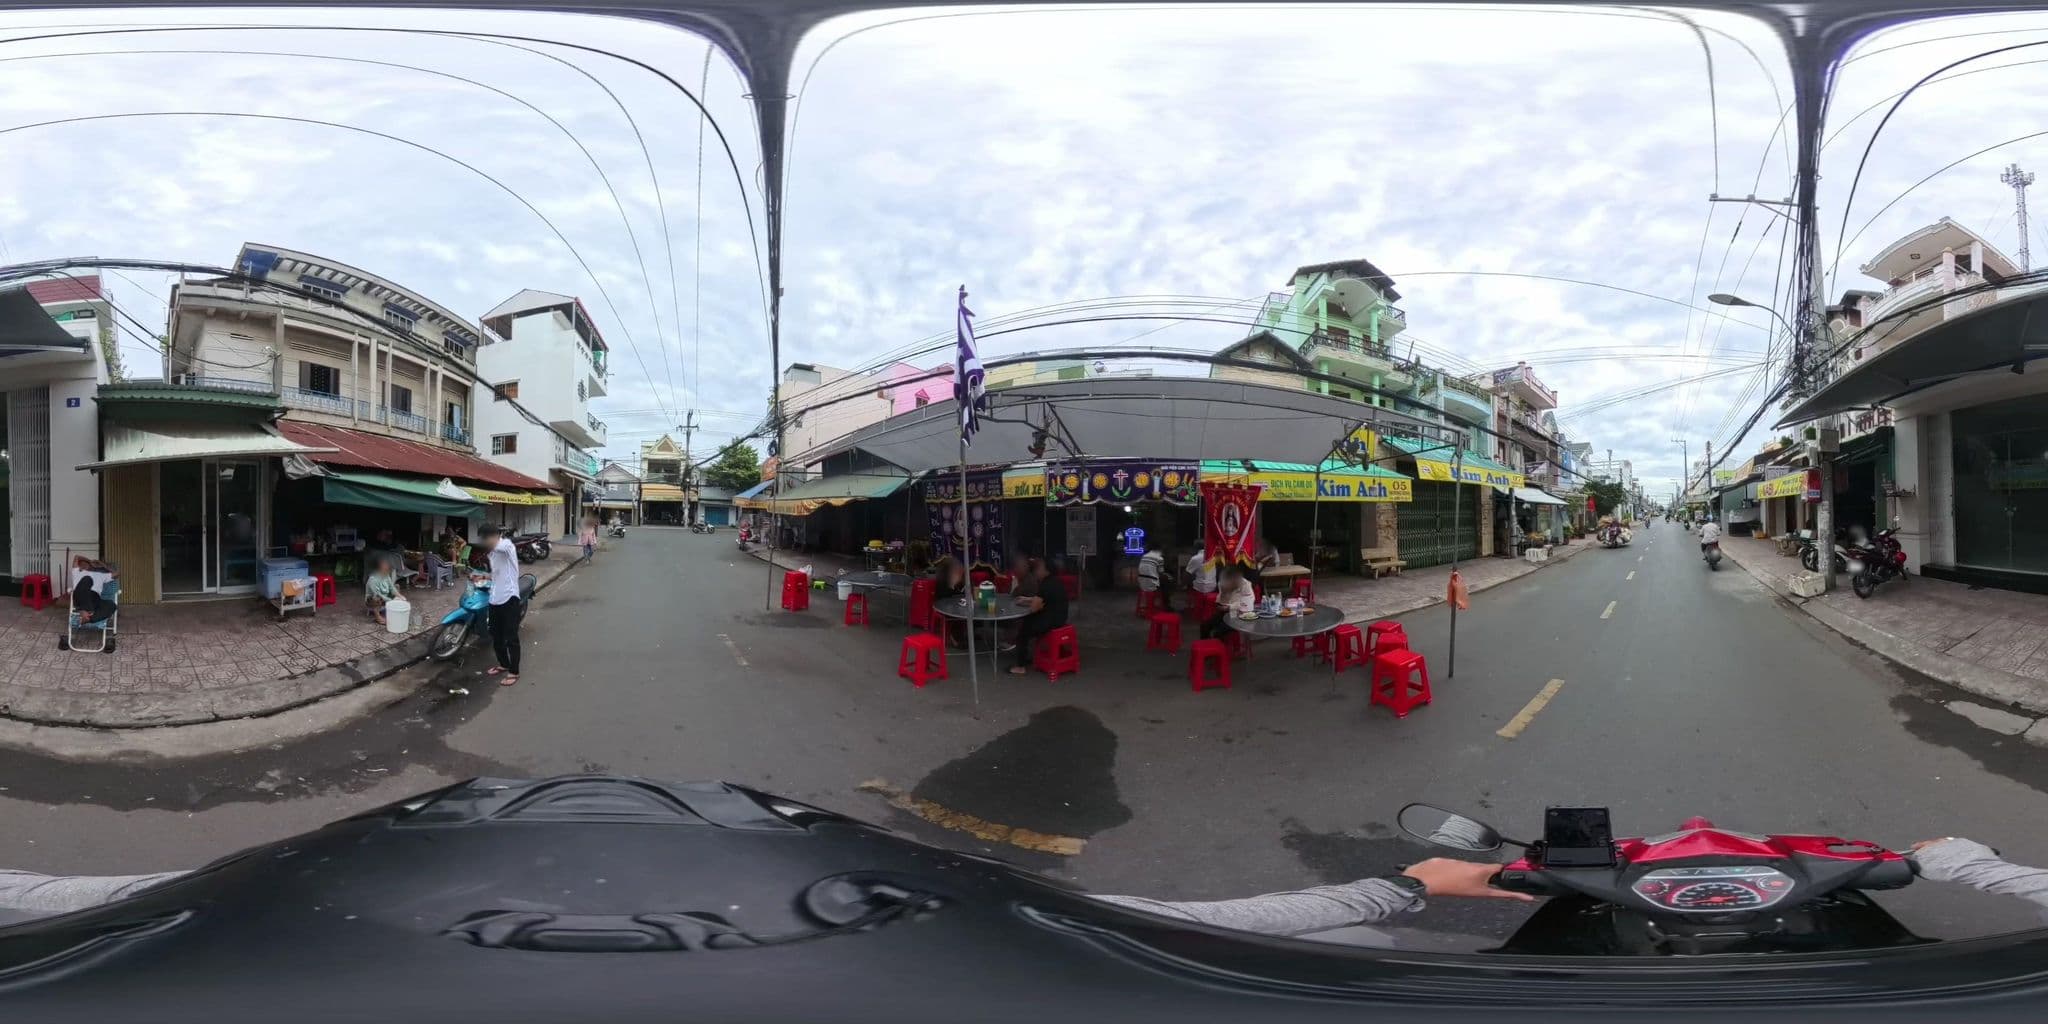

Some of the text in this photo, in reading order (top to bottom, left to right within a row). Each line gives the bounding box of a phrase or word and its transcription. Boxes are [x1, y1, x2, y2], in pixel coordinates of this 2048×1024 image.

[1487, 473, 1509, 486] Anh
[1032, 484, 1043, 495] XE
[1318, 480, 1351, 496] Kim
[1357, 481, 1387, 497] Anh
[1392, 481, 1407, 491] 05
